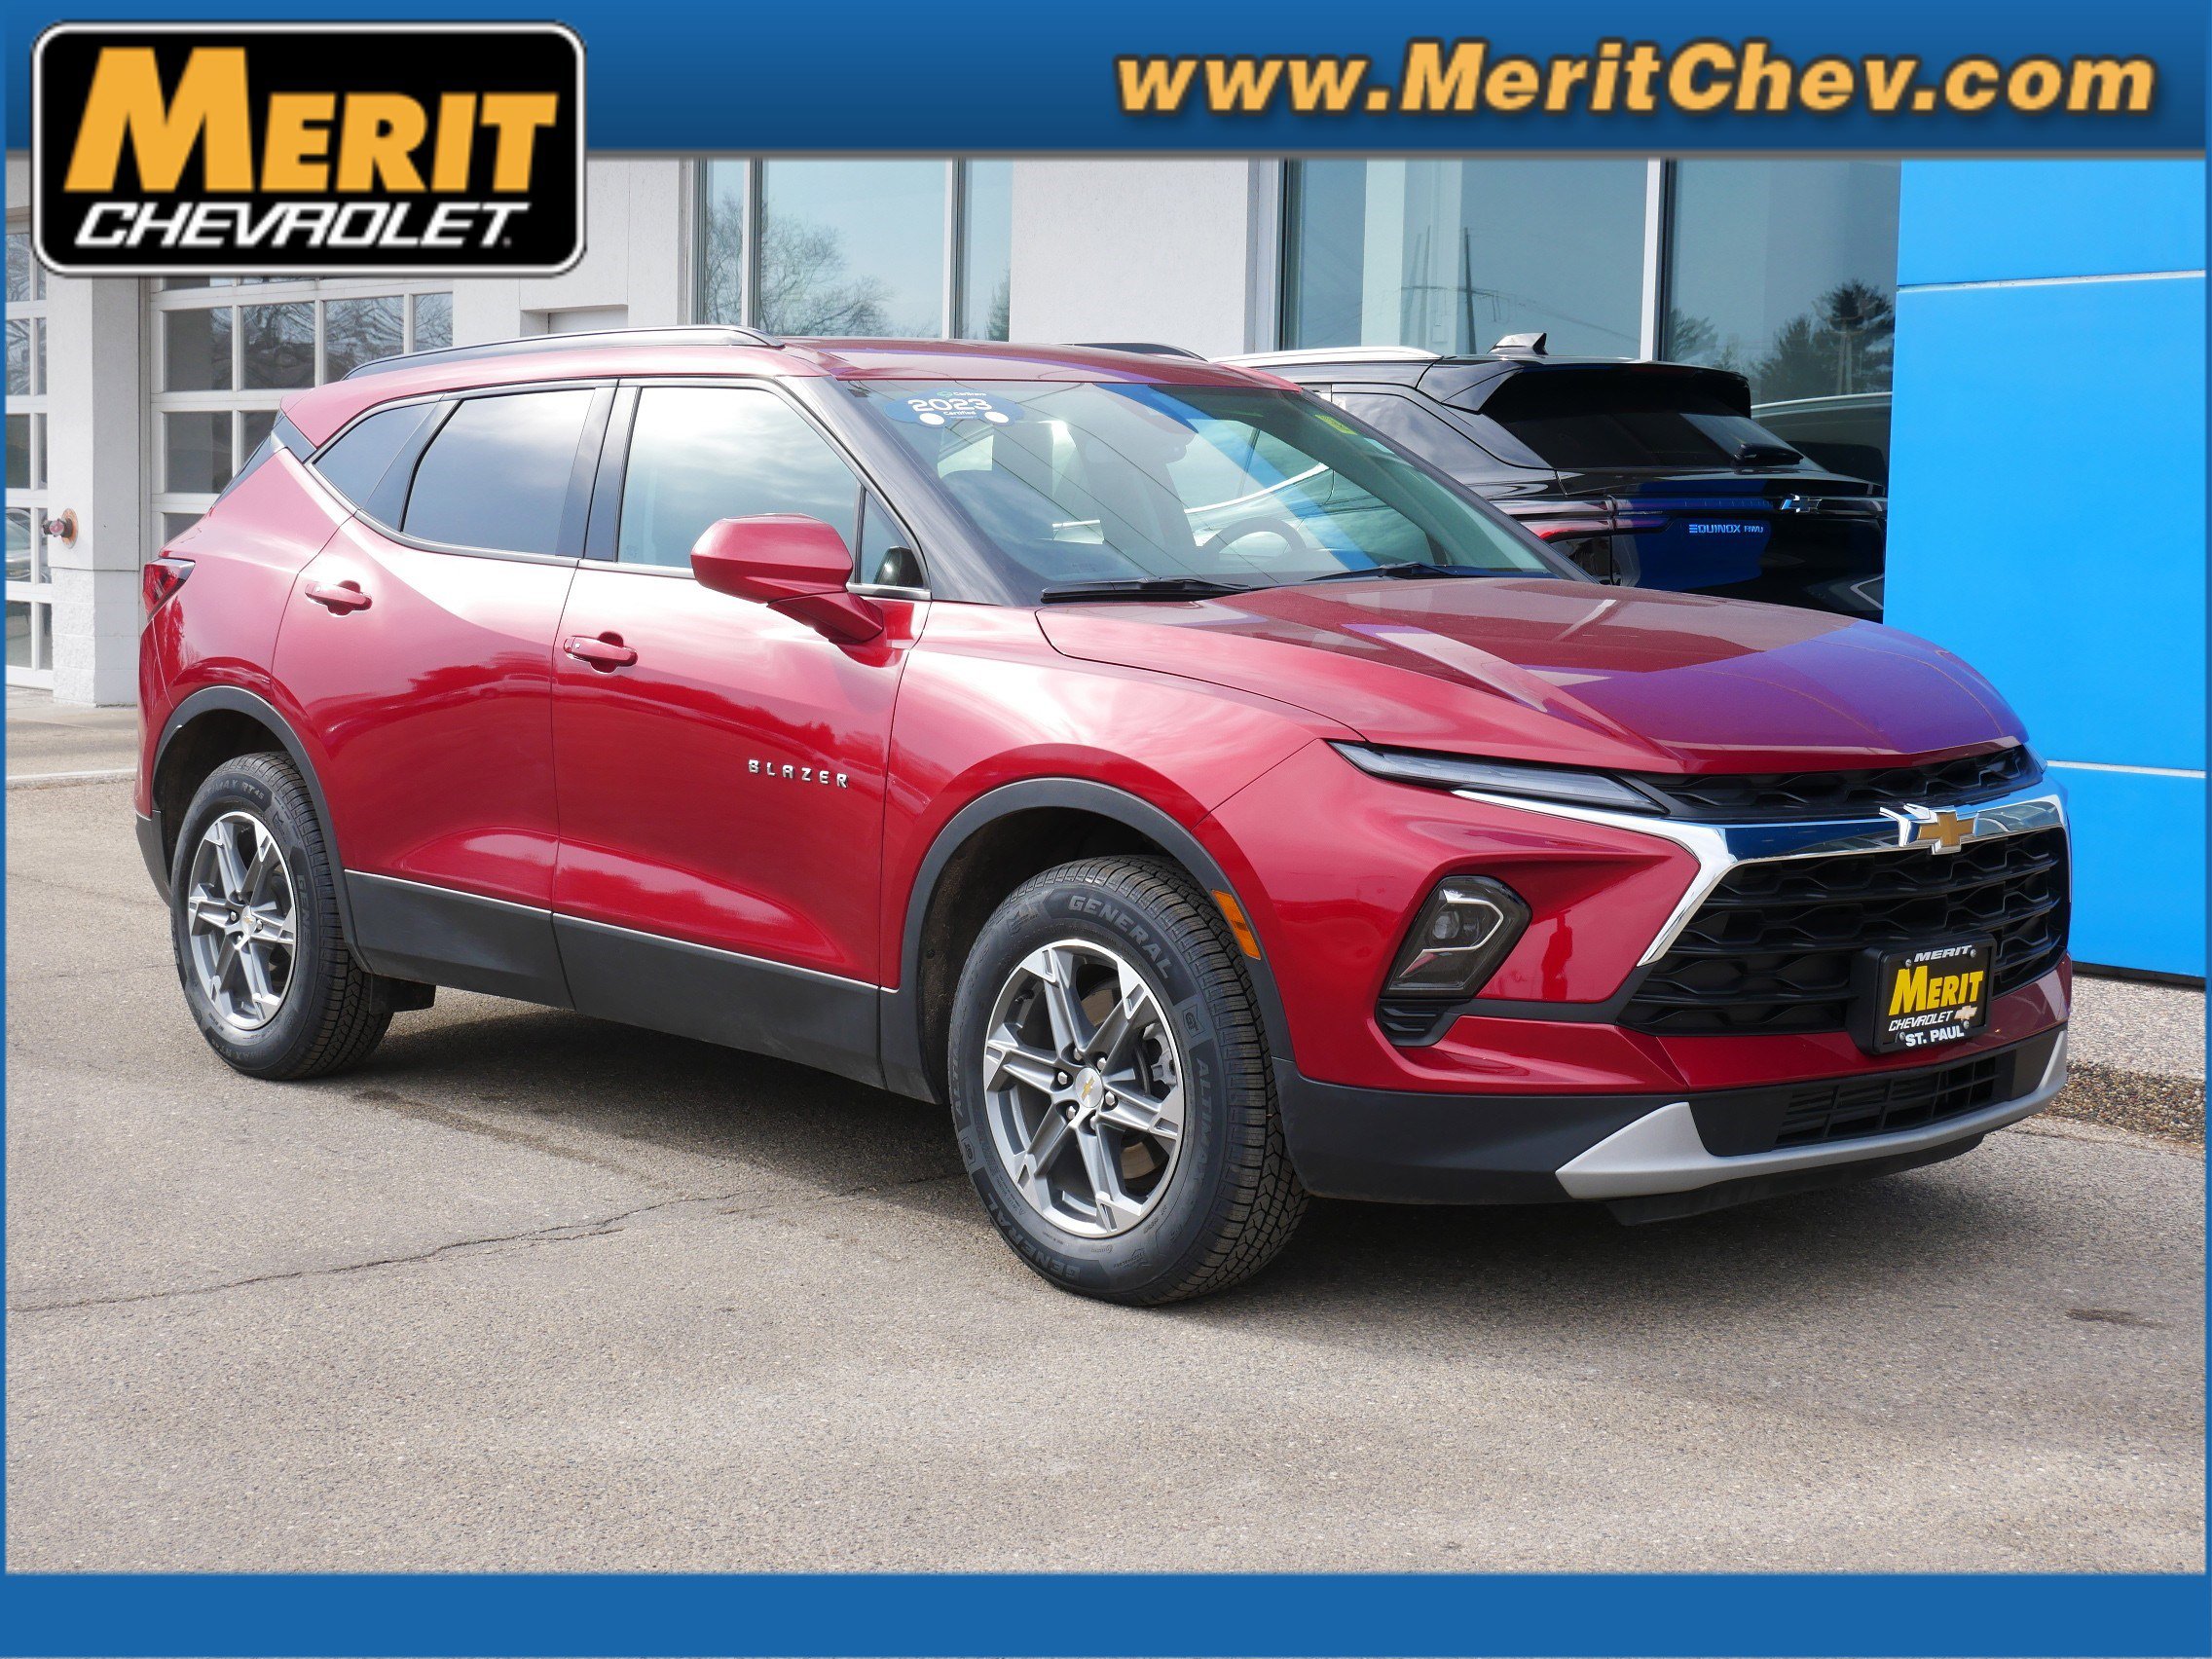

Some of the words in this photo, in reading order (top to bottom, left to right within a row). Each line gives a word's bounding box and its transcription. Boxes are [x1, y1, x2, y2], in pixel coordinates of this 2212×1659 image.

[907, 398, 992, 412] 2023
[1688, 524, 1741, 534] EQUINOX
[748, 758, 848, 789] BLAZER
[1068, 895, 1172, 979] GENERAL
[1913, 944, 1972, 963] MERIT
[1888, 965, 1984, 1016] MERIT
[1888, 1010, 1953, 1032] CHEVROLET
[1905, 1032, 1928, 1048] ST.
[1930, 1025, 1965, 1043] PAUL
[987, 1193, 1081, 1278] GENERAL
